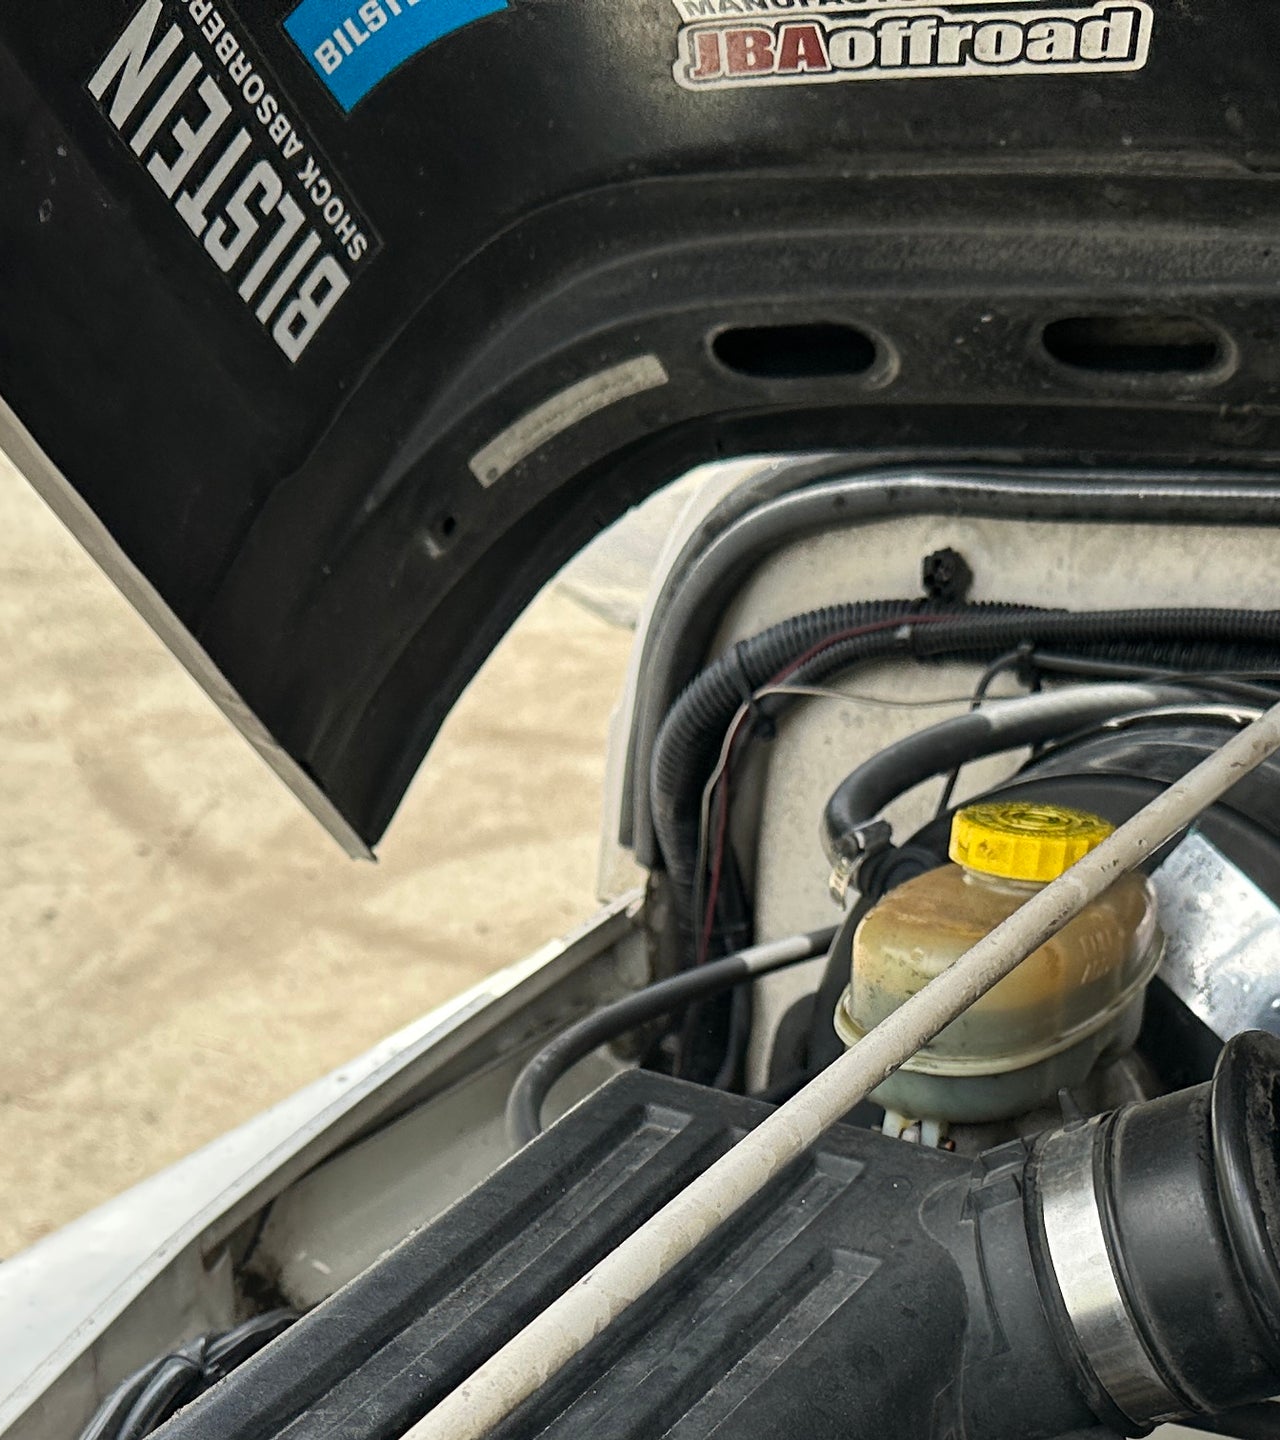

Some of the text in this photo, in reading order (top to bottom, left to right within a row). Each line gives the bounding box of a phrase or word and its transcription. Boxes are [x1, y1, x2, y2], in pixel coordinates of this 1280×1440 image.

[181, 0, 368, 261] SHOCK ABSORBER
[313, 0, 420, 75] BILST
[87, 0, 351, 364] BILSTEIN
